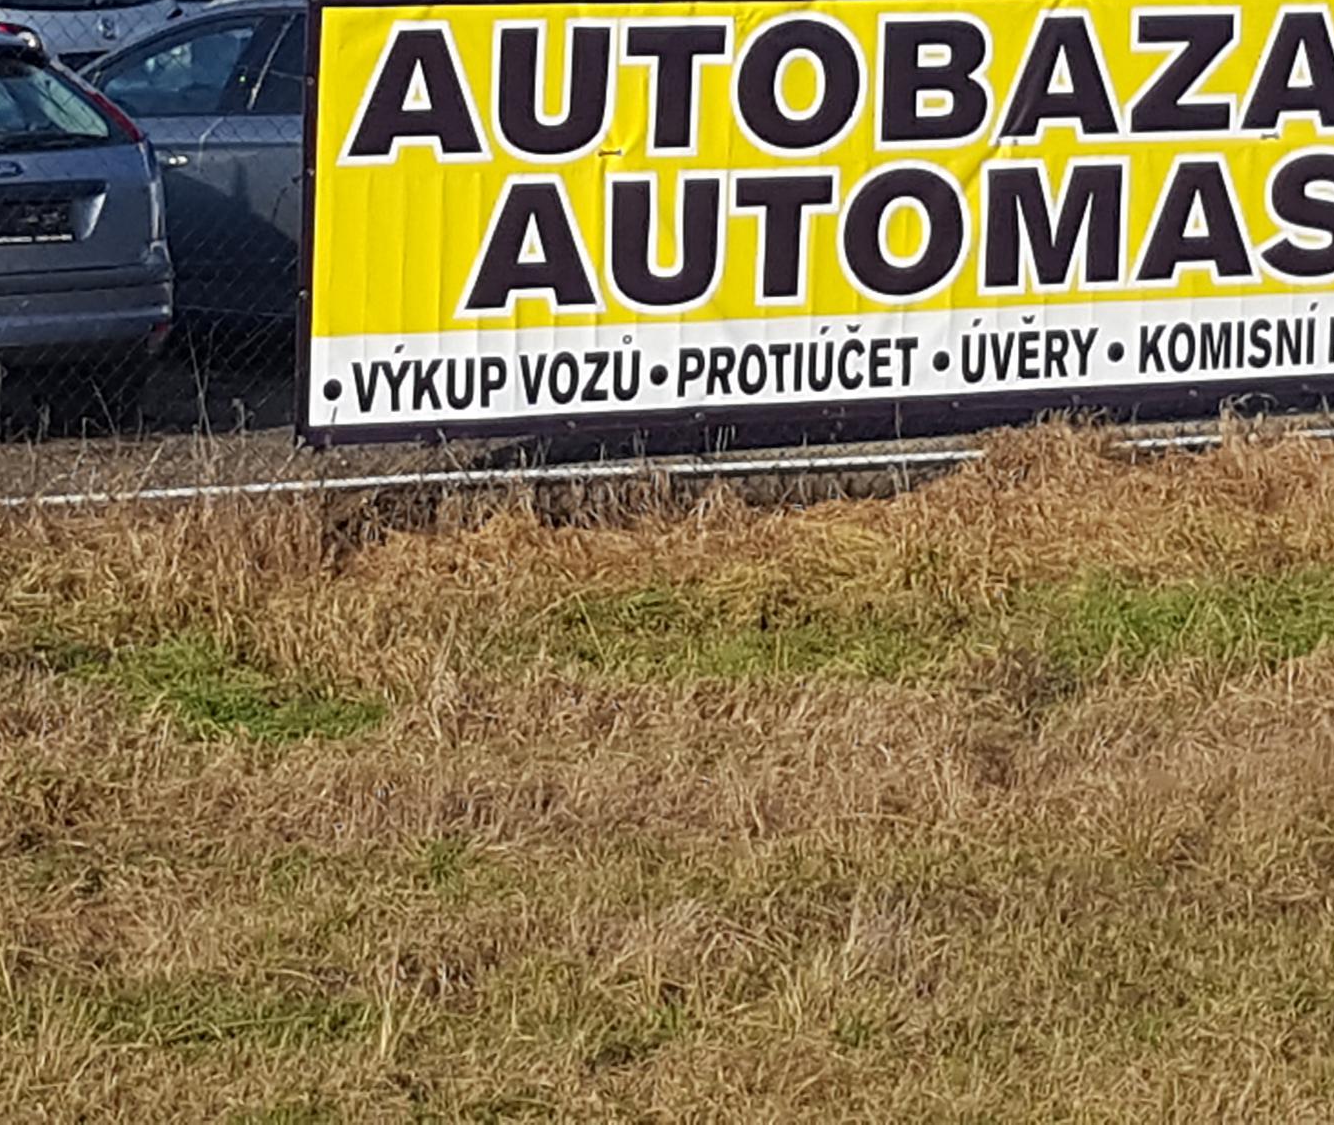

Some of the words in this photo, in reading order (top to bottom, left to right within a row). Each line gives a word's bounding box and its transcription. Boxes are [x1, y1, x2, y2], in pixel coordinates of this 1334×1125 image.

[352, 344, 508, 413] VÝKUP
[519, 334, 642, 406] VOZŮ
[676, 324, 919, 398] PROTIÚČET
[960, 315, 1099, 385] ÚVĚRY
[1138, 302, 1319, 374] KOMISNÍ
